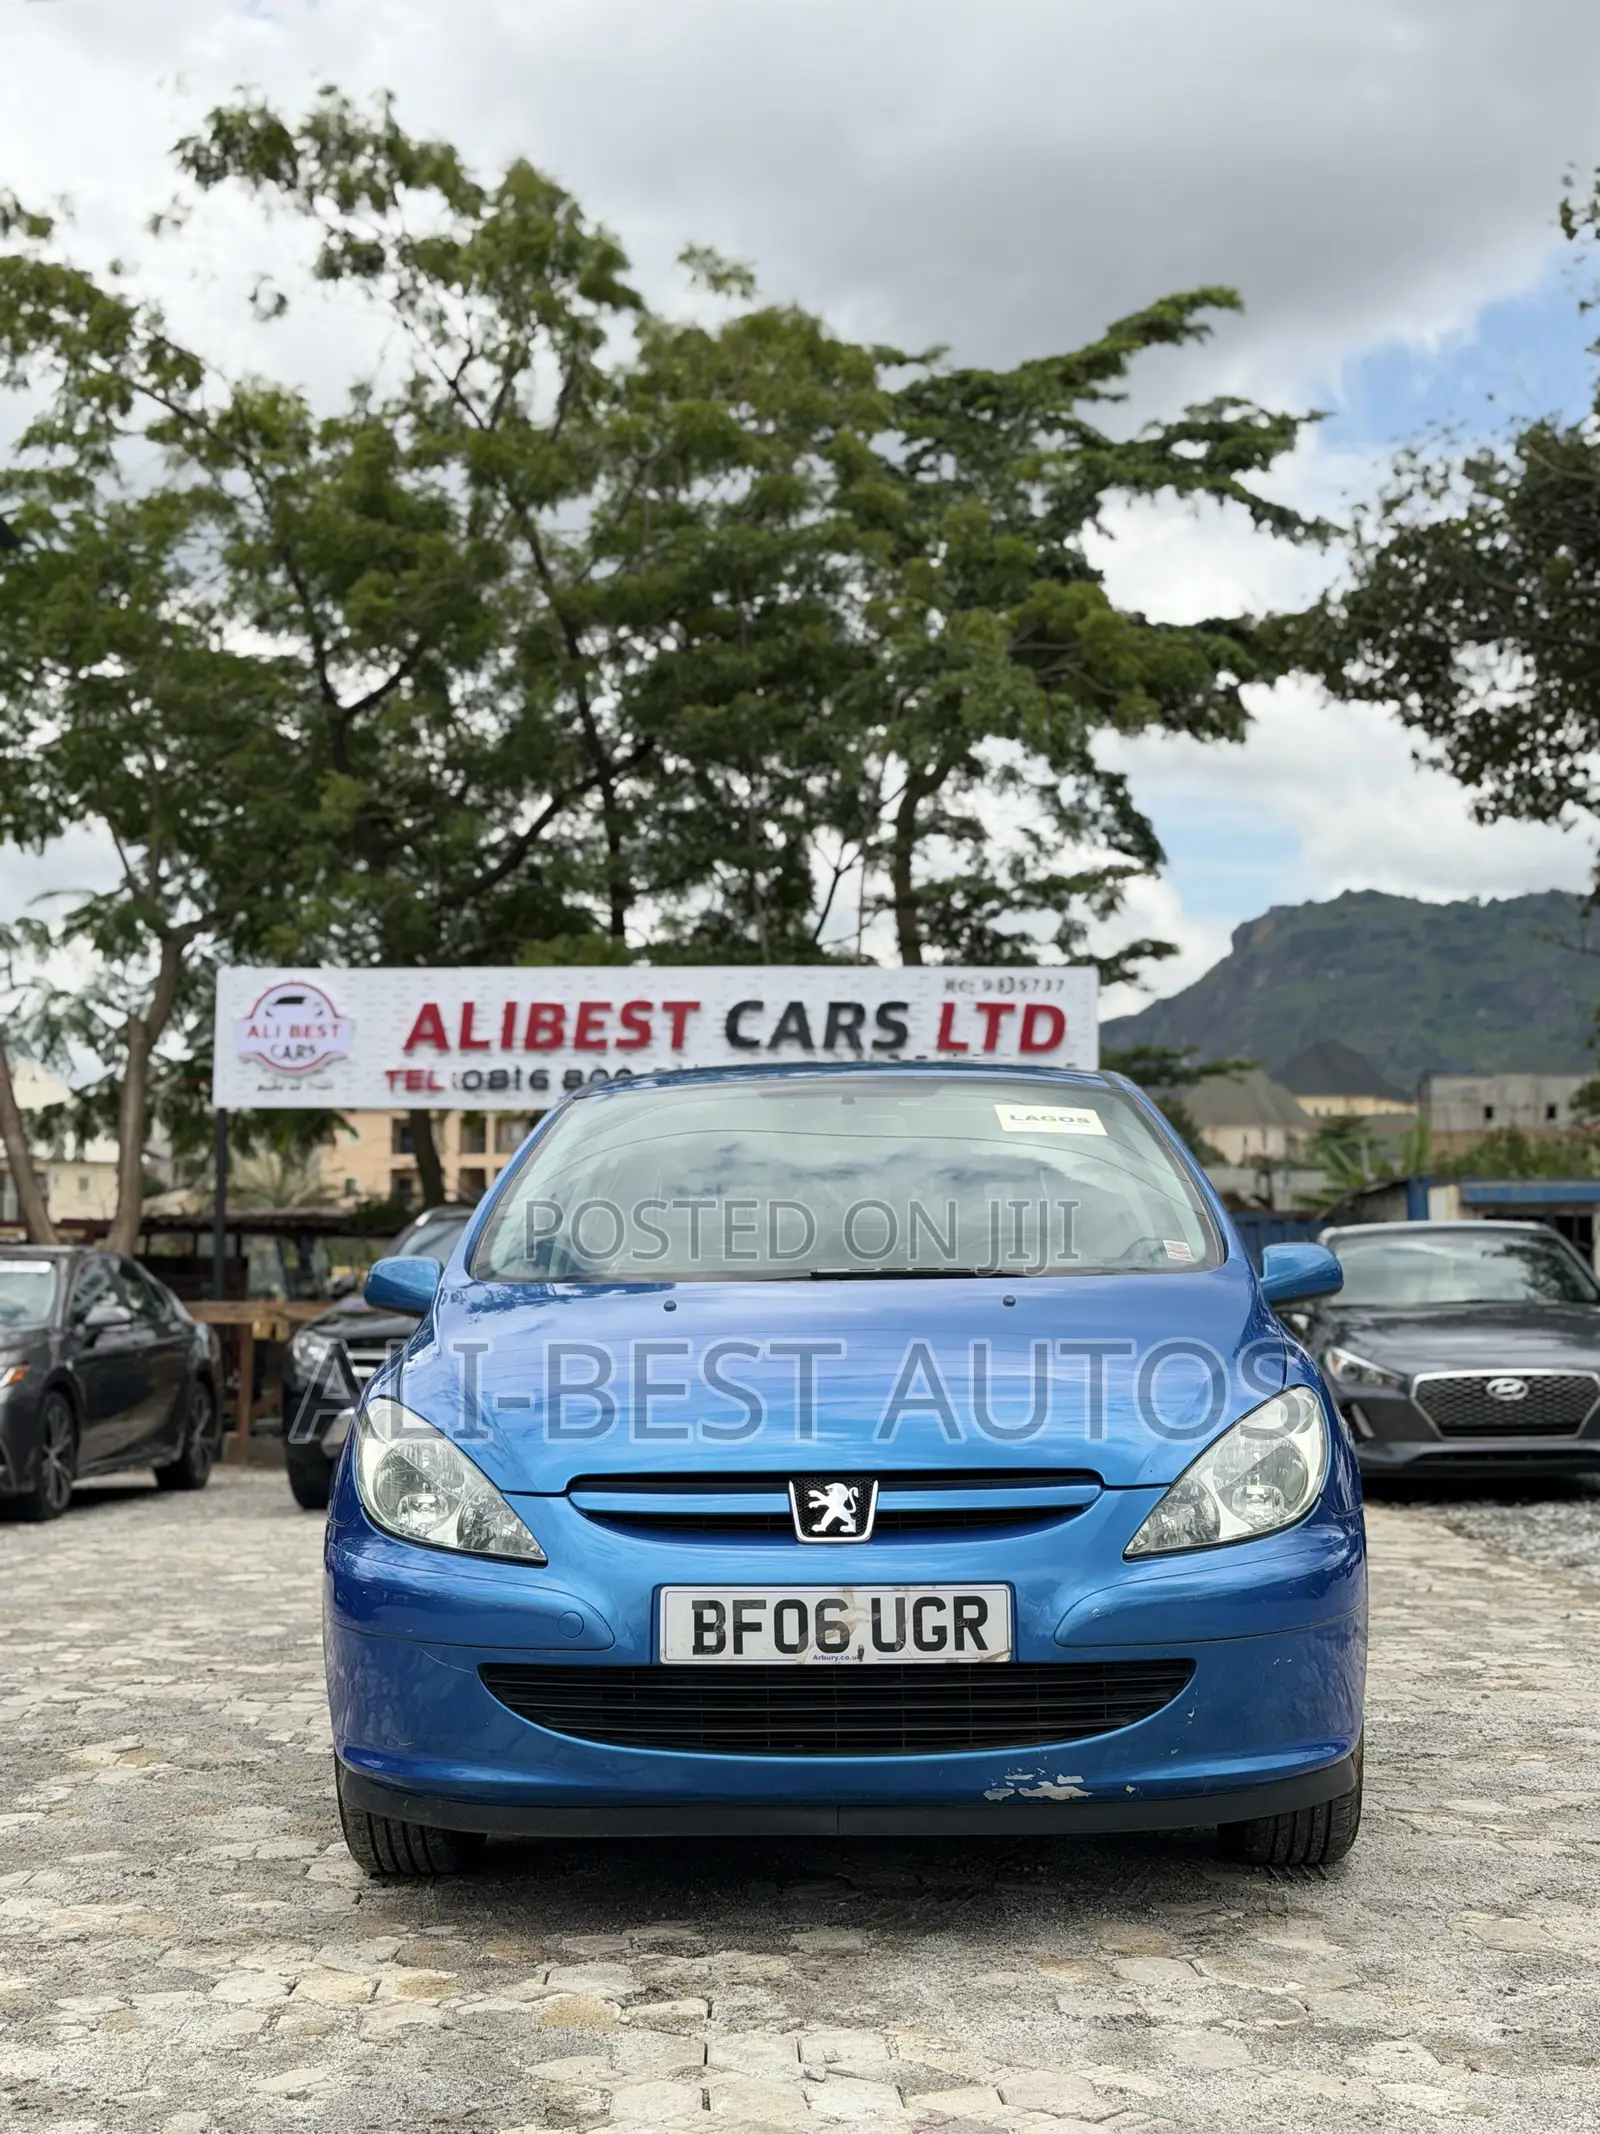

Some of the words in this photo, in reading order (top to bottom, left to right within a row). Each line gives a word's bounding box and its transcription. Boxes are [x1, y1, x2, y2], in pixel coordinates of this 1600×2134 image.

[247, 1025, 281, 1039] ALI
[289, 1024, 339, 1038] BEST
[403, 1000, 700, 1053] ALIBEST
[724, 999, 910, 1051] CARS
[936, 1001, 1067, 1053] LTD
[270, 1043, 316, 1060] CARS
[1009, 1114, 1091, 1125] LAGOS
[691, 1598, 850, 1655] BF06
[871, 1596, 989, 1654] UGR
[813, 1654, 863, 1662] Arbury.co.u
